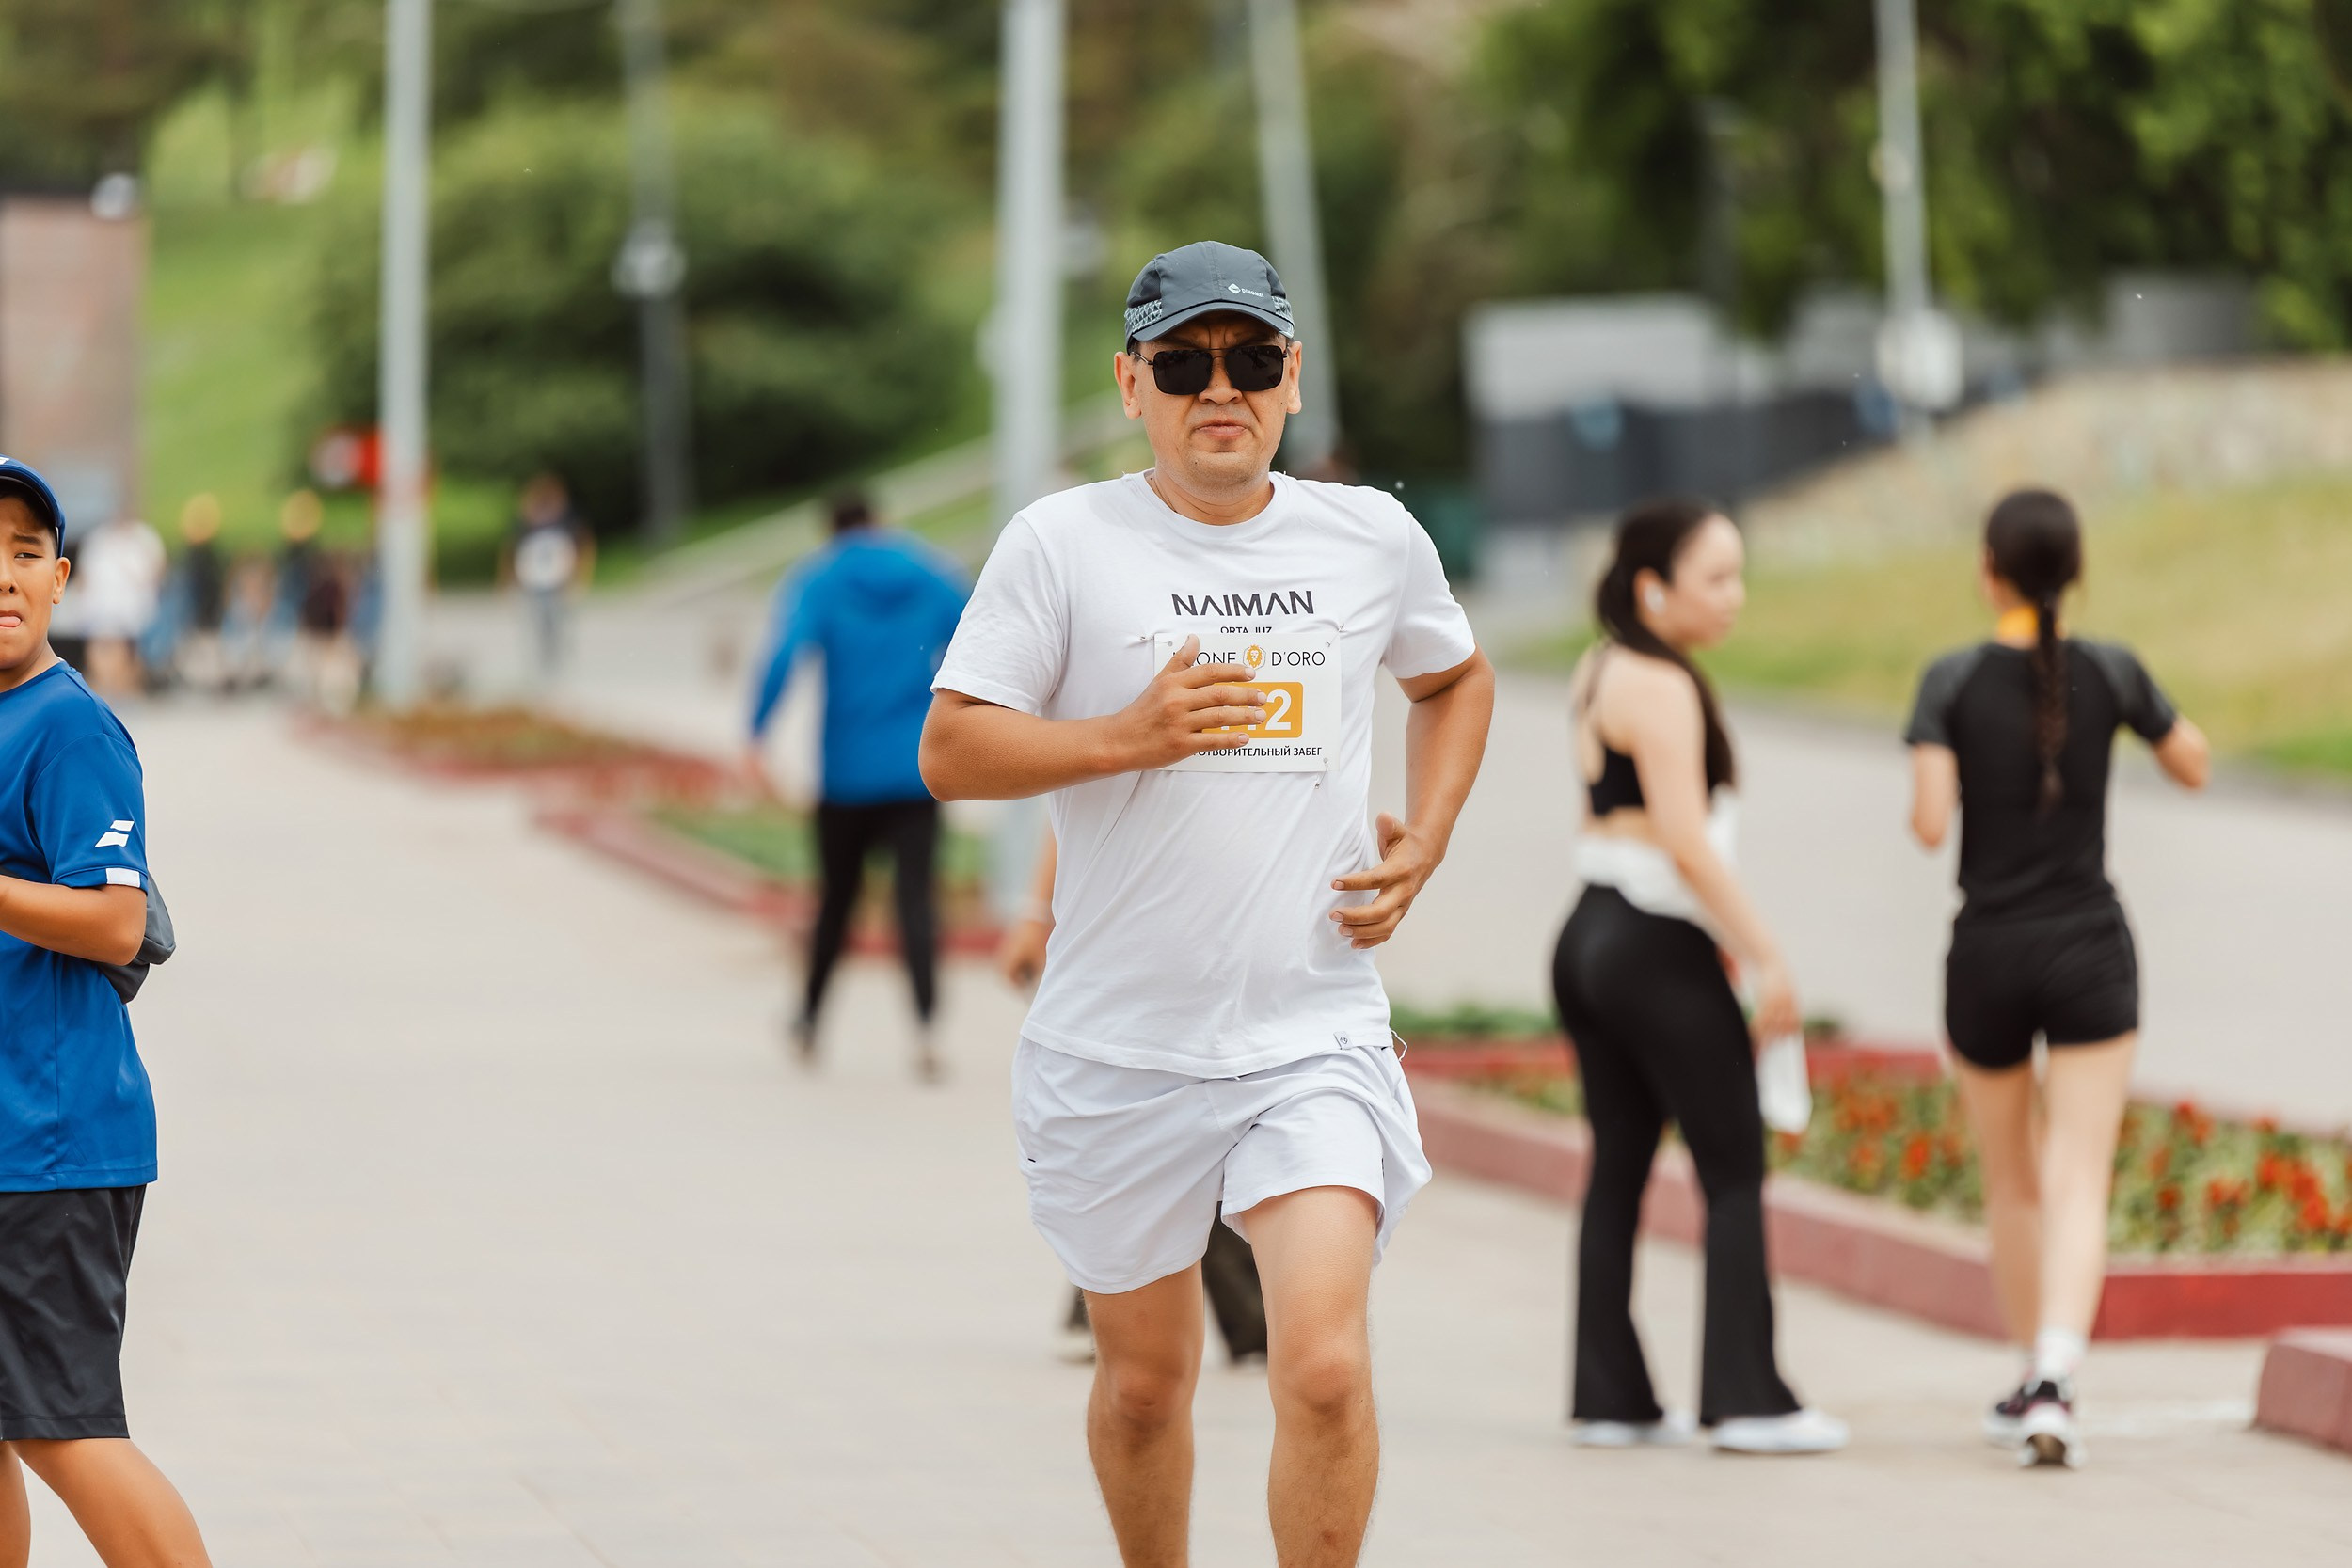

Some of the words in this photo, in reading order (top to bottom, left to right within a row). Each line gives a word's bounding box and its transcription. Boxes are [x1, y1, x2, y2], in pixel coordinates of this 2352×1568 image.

[1171, 590, 1314, 617] NAIMAN
[1173, 651, 1236, 665] ONE
[1271, 651, 1326, 667] D'ORO
[1194, 745, 1291, 757] ВОРИТЕЛЬНЫЙ
[1293, 747, 1323, 756] ЗАБЕГ
